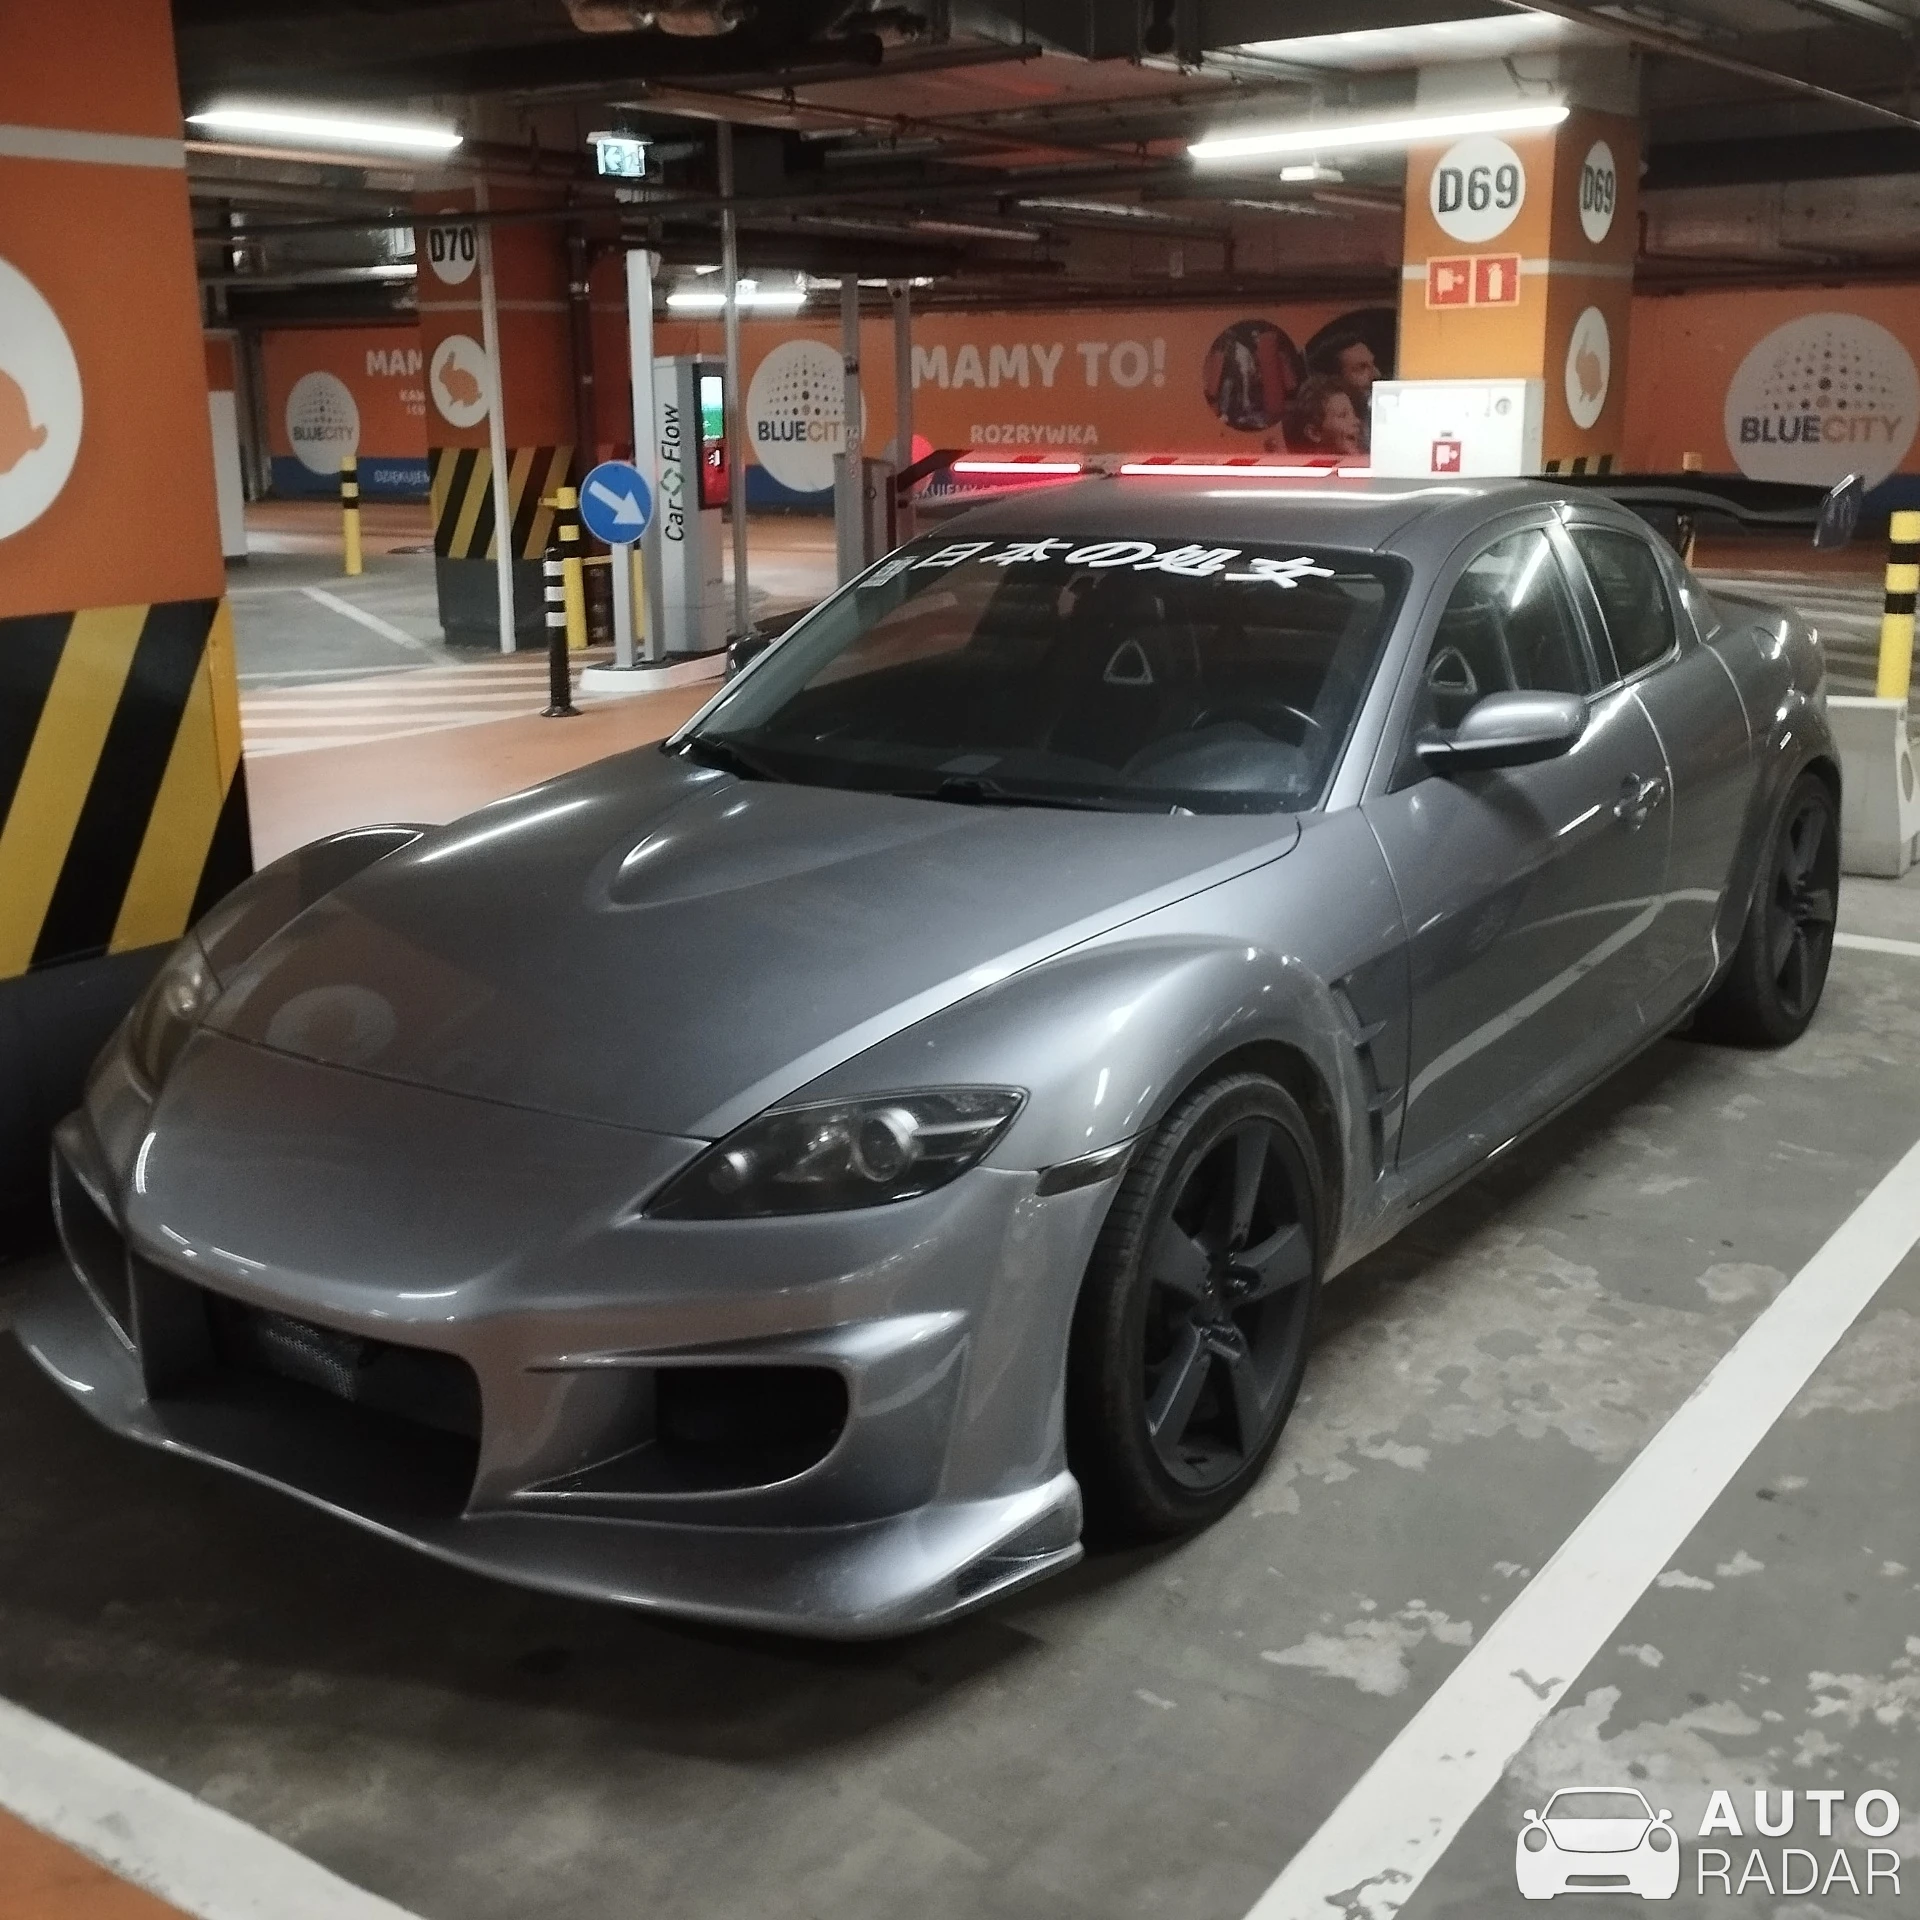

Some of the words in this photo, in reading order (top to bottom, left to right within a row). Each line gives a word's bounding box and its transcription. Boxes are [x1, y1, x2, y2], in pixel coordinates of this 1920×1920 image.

[1438, 164, 1519, 213] D69
[1583, 164, 1613, 215] D69
[430, 226, 475, 262] D70
[911, 344, 1064, 389] MAMY
[1077, 338, 1166, 388] TO!
[293, 425, 354, 442] BLUECITY
[661, 403, 682, 463] Flow
[757, 420, 845, 442] BLUECIT
[970, 424, 1098, 445] ROZRYWKA
[1740, 414, 1904, 444] BLUECITY
[664, 498, 684, 542] Car
[911, 538, 1335, 588] 日本の処女
